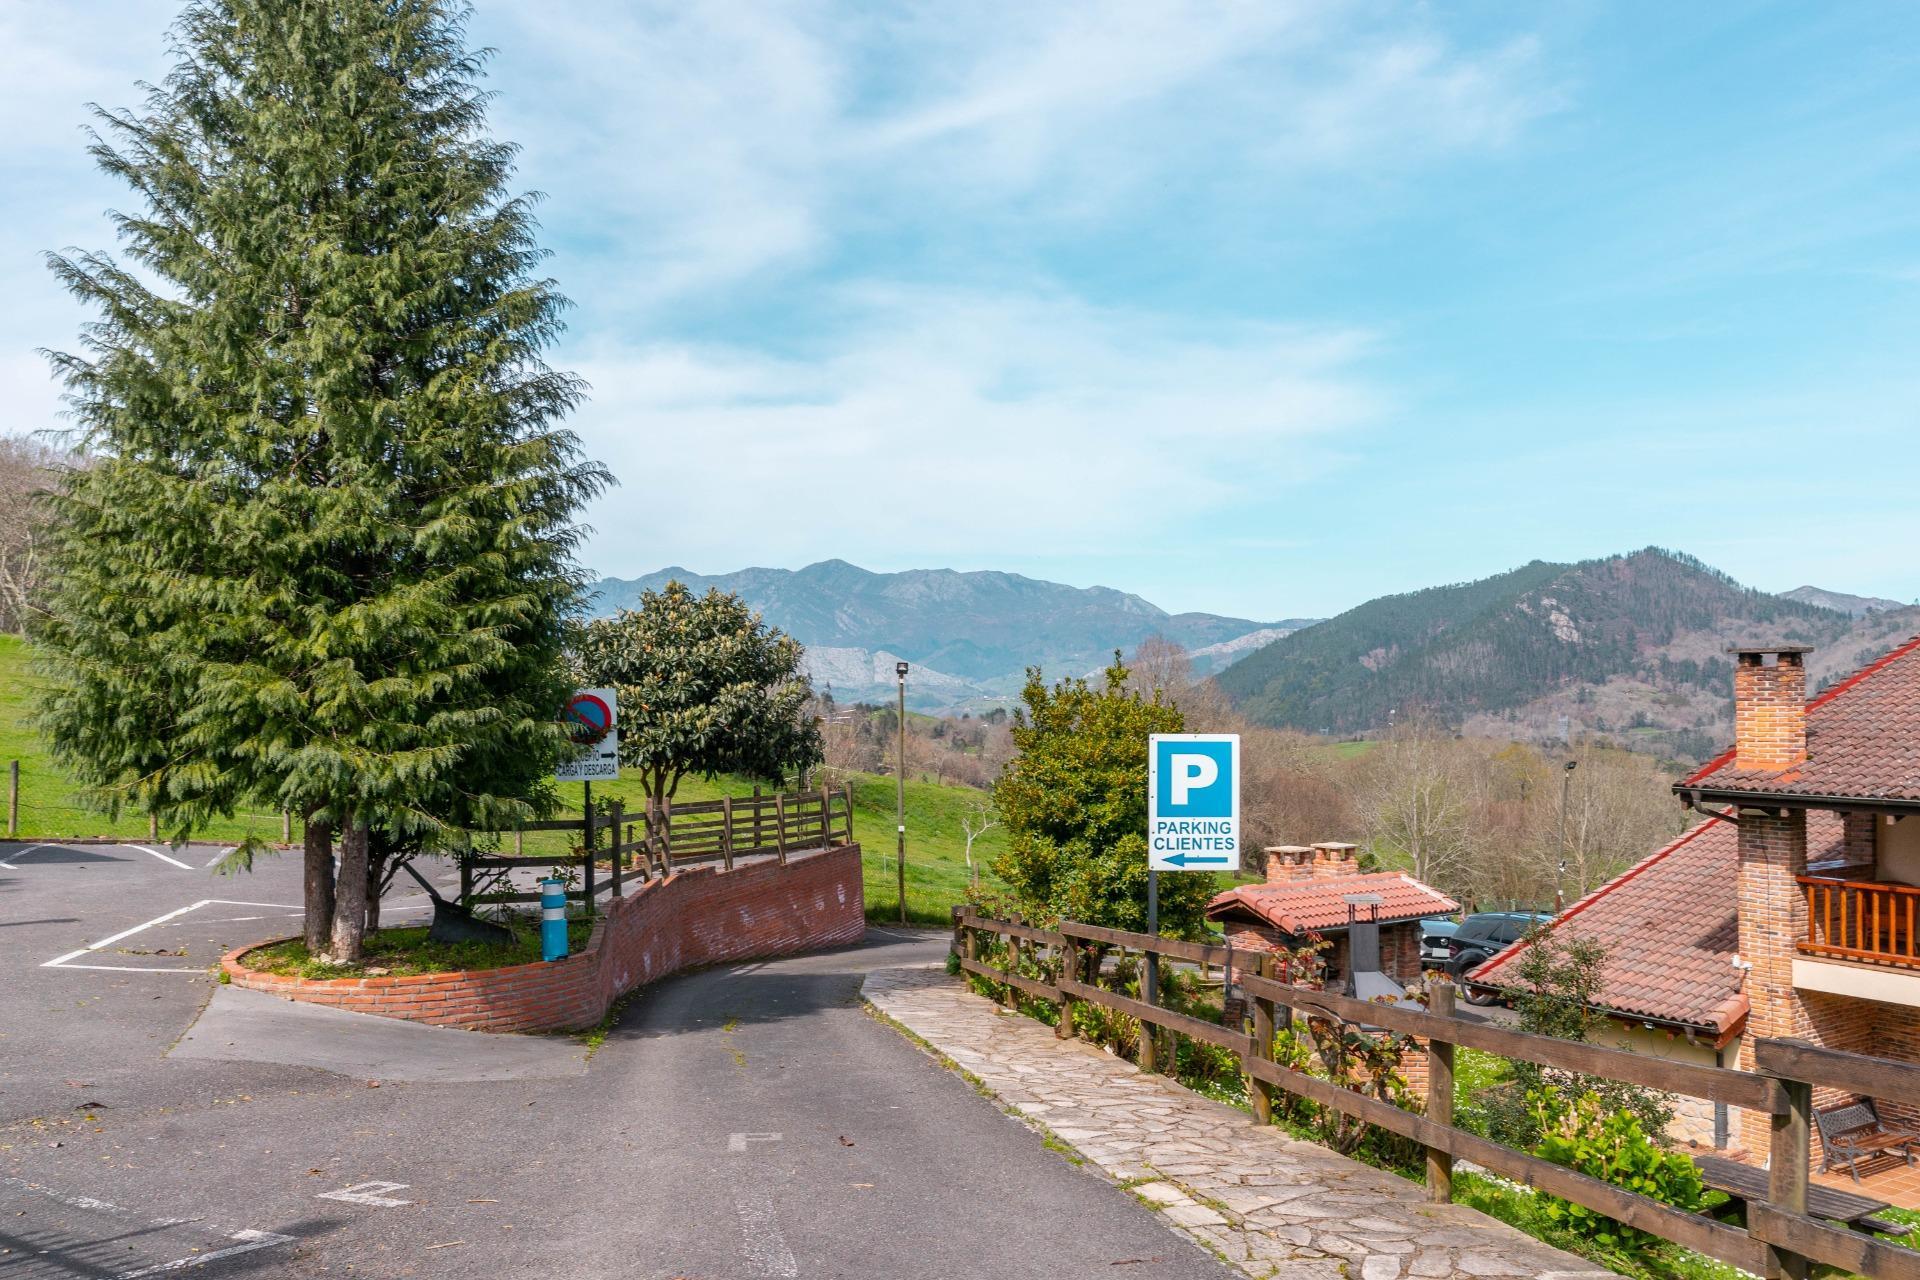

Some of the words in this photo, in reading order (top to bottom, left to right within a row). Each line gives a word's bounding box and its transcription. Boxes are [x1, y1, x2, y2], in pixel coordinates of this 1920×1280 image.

[558, 764, 578, 776] CARGA
[585, 763, 616, 775] DESCARGA
[1171, 754, 1218, 805] P
[1157, 822, 1231, 834] PARKING
[1154, 837, 1234, 850] CLIENTES
